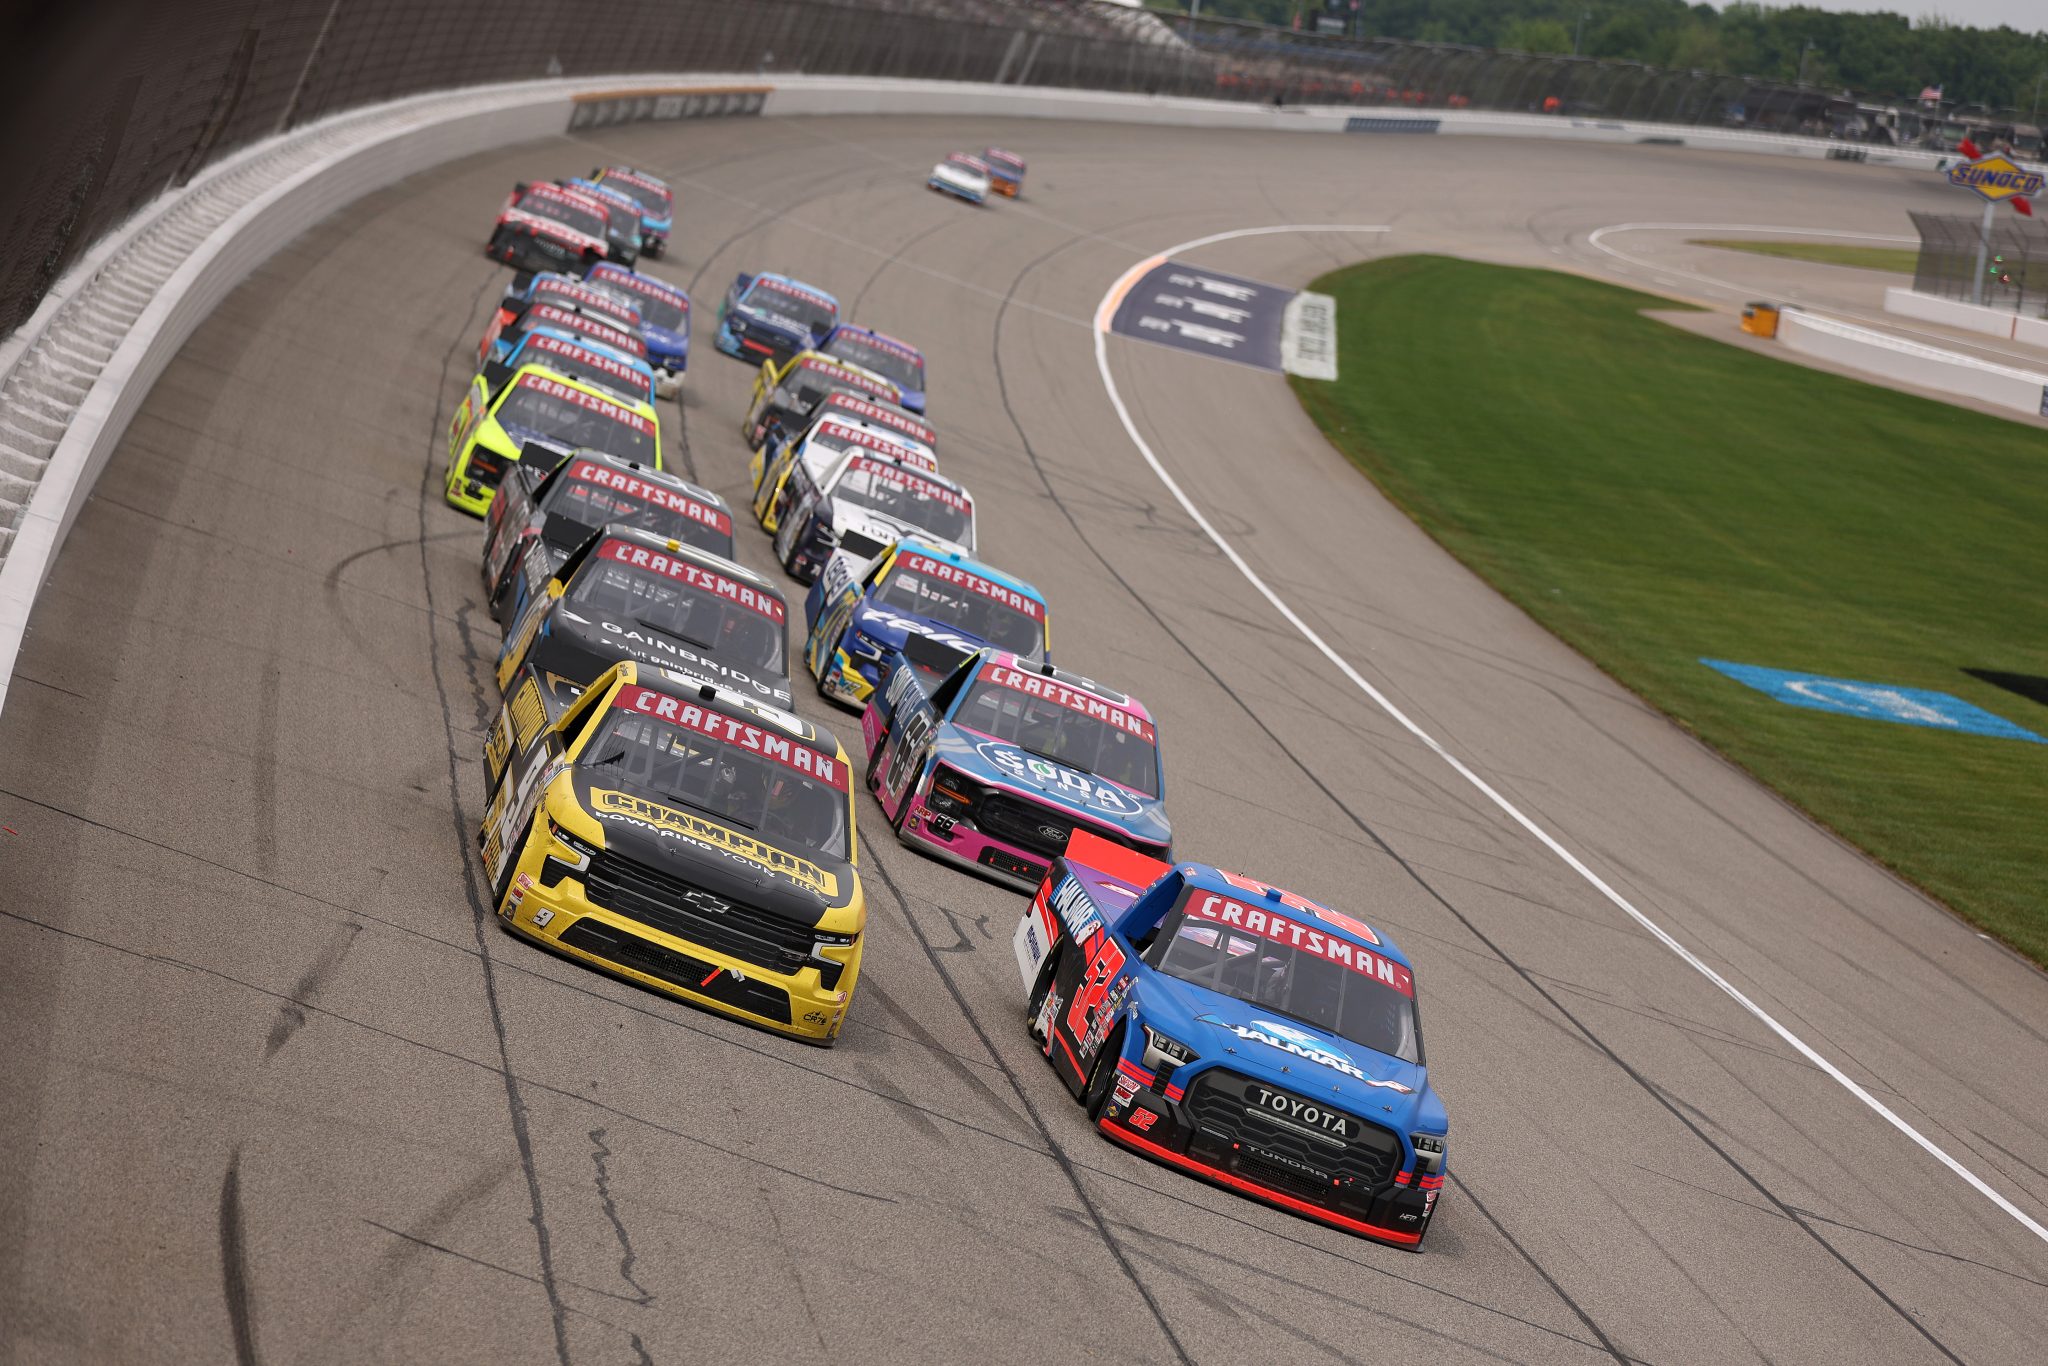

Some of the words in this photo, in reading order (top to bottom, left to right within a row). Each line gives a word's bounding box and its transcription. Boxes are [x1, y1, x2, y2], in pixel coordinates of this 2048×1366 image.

[1955, 165, 2041, 192] SUNOCO
[541, 280, 632, 320] CRAFTSMAN
[600, 269, 682, 310] CRAFTSMAN
[539, 306, 640, 351] CRAFTSMAN
[536, 336, 642, 384] CRAFTSMAN
[808, 359, 893, 400] CRAFTSMAN
[526, 375, 645, 430] CRAFTSMAN
[835, 394, 927, 438] CRAFTSMAN
[828, 422, 929, 471] CRAFTSMAN
[580, 465, 717, 526] CRAFTSMAN
[859, 457, 966, 510] CRAFTSMAN
[616, 546, 772, 616] CRAFTSMAN
[909, 556, 1037, 617] CRAFTSMAN
[601, 621, 792, 704] GAINBRIDGE
[991, 667, 1142, 735] CRAFTSMAN
[635, 691, 833, 784] CRAFTSMAN
[993, 748, 1127, 809] SODA
[595, 810, 713, 851] POWERING
[719, 848, 777, 879] YOUR
[602, 791, 828, 891] CHAMPION
[1201, 895, 1397, 986] CRAFTSMAN
[1128, 1106, 1159, 1132] 52
[1259, 1088, 1347, 1136] TOYOTA
[1246, 1144, 1328, 1180] TUNDRA
